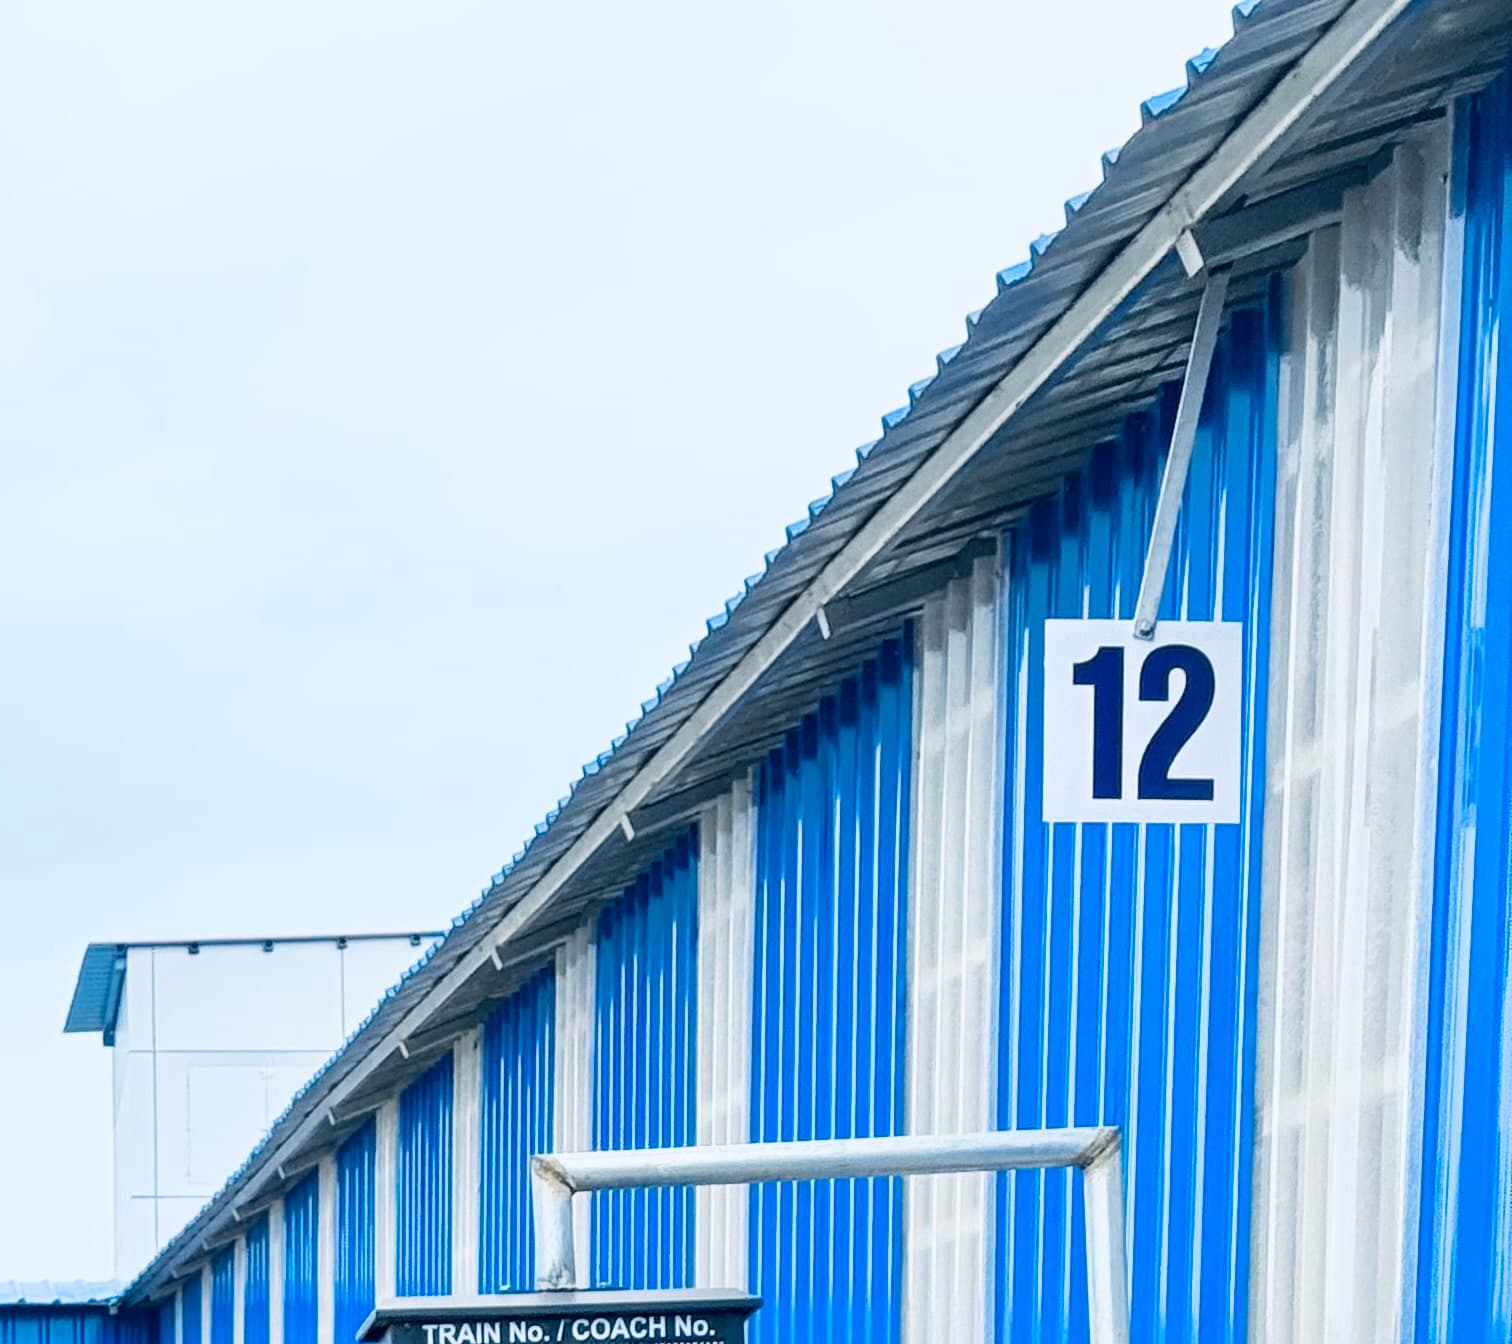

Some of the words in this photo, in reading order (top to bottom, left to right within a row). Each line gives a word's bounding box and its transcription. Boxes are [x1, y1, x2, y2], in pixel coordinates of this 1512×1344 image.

[1072, 643, 1216, 802] 12
[508, 1319, 551, 1344] No.
[556, 1319, 566, 1342] /
[571, 1314, 667, 1341] COACH
[674, 1314, 716, 1337] No.
